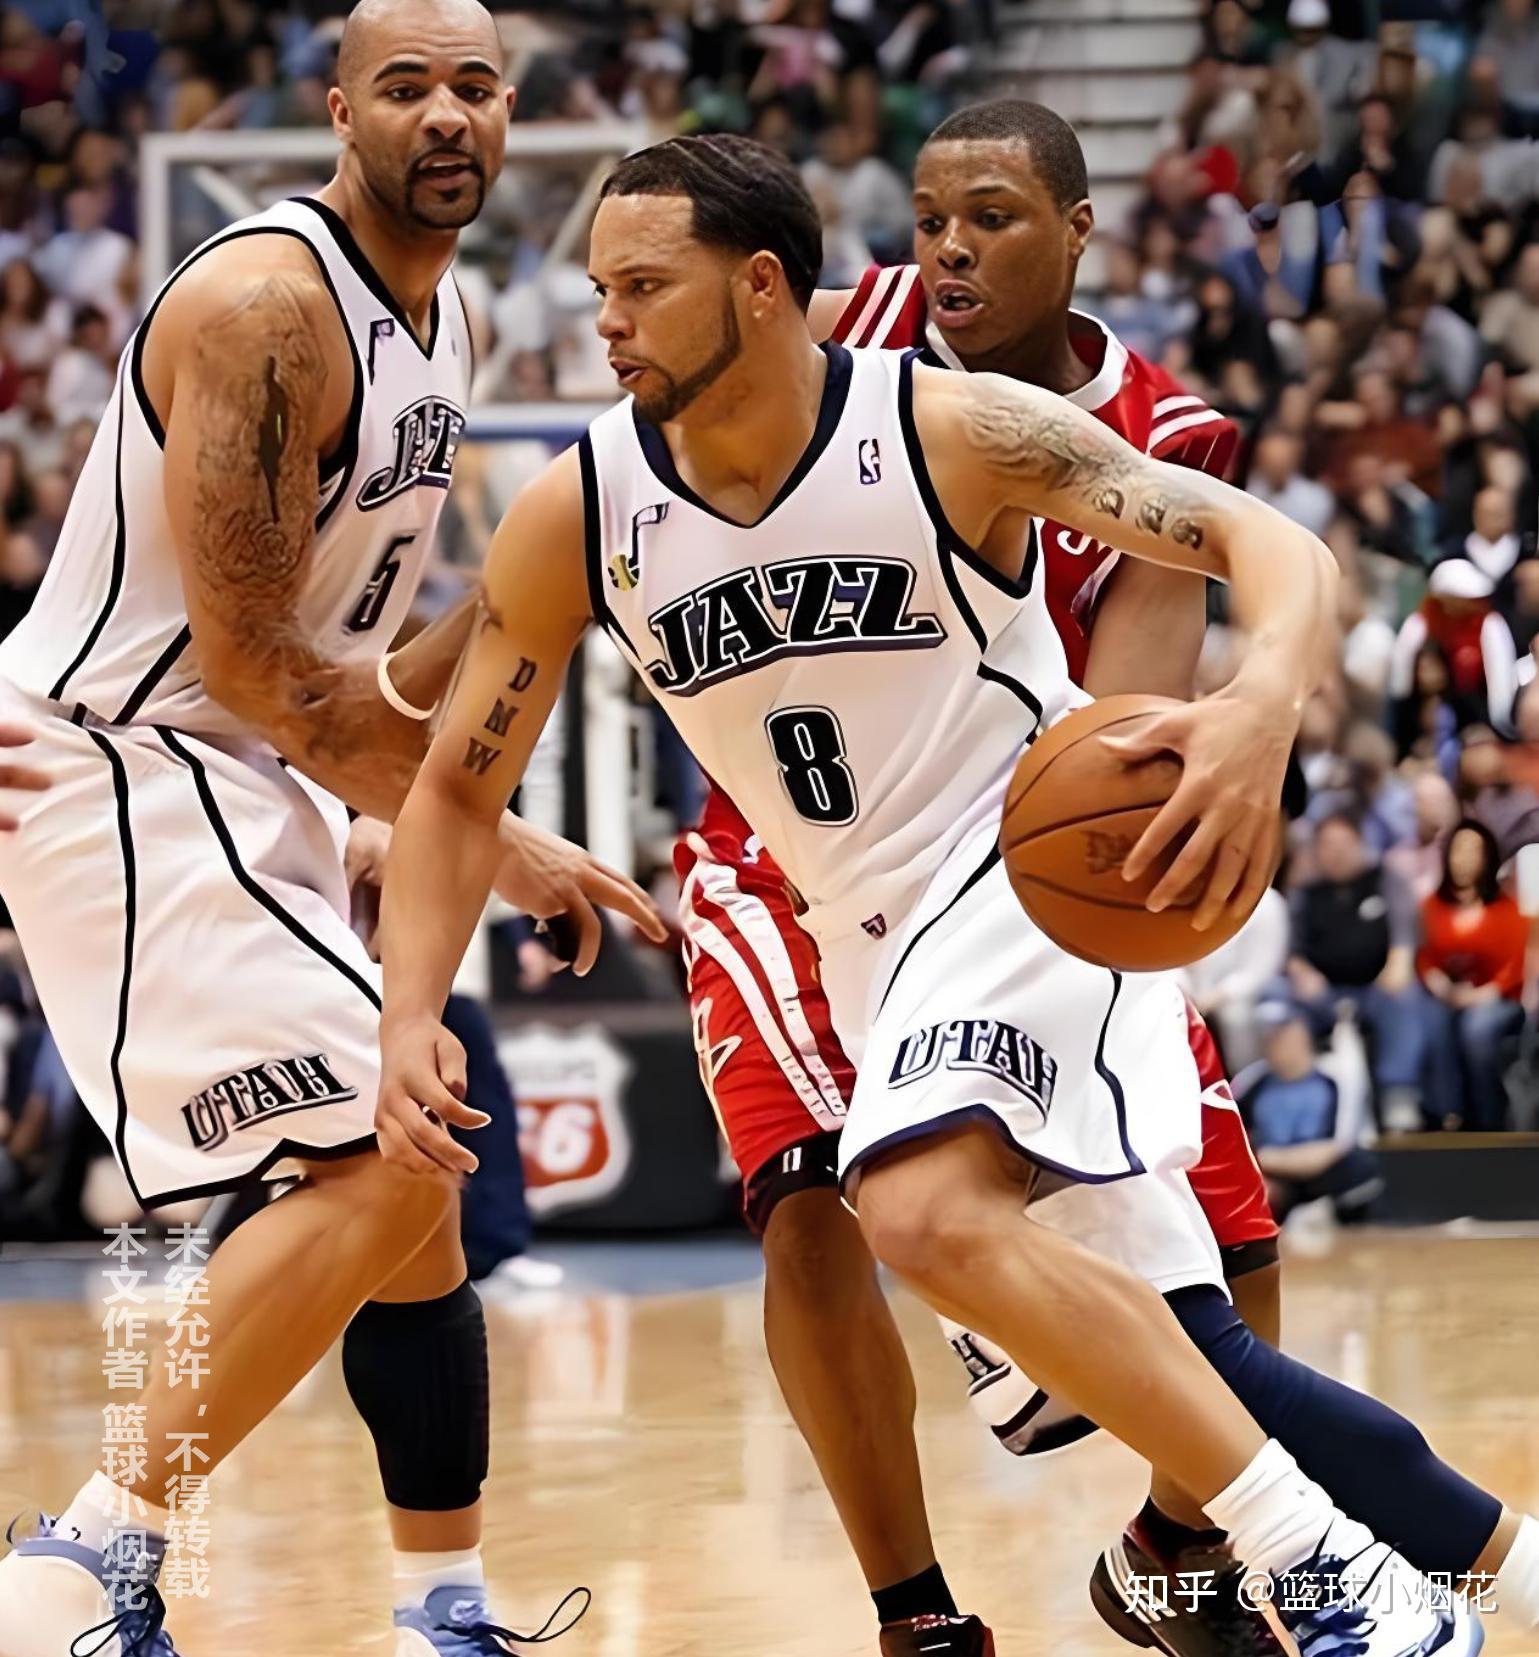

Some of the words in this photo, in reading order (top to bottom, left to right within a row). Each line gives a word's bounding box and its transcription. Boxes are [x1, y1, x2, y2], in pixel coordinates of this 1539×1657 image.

[342, 531, 418, 632] 5
[645, 554, 948, 697] JAZZ
[764, 705, 859, 826] 8
[180, 1053, 359, 1152] UTAH
